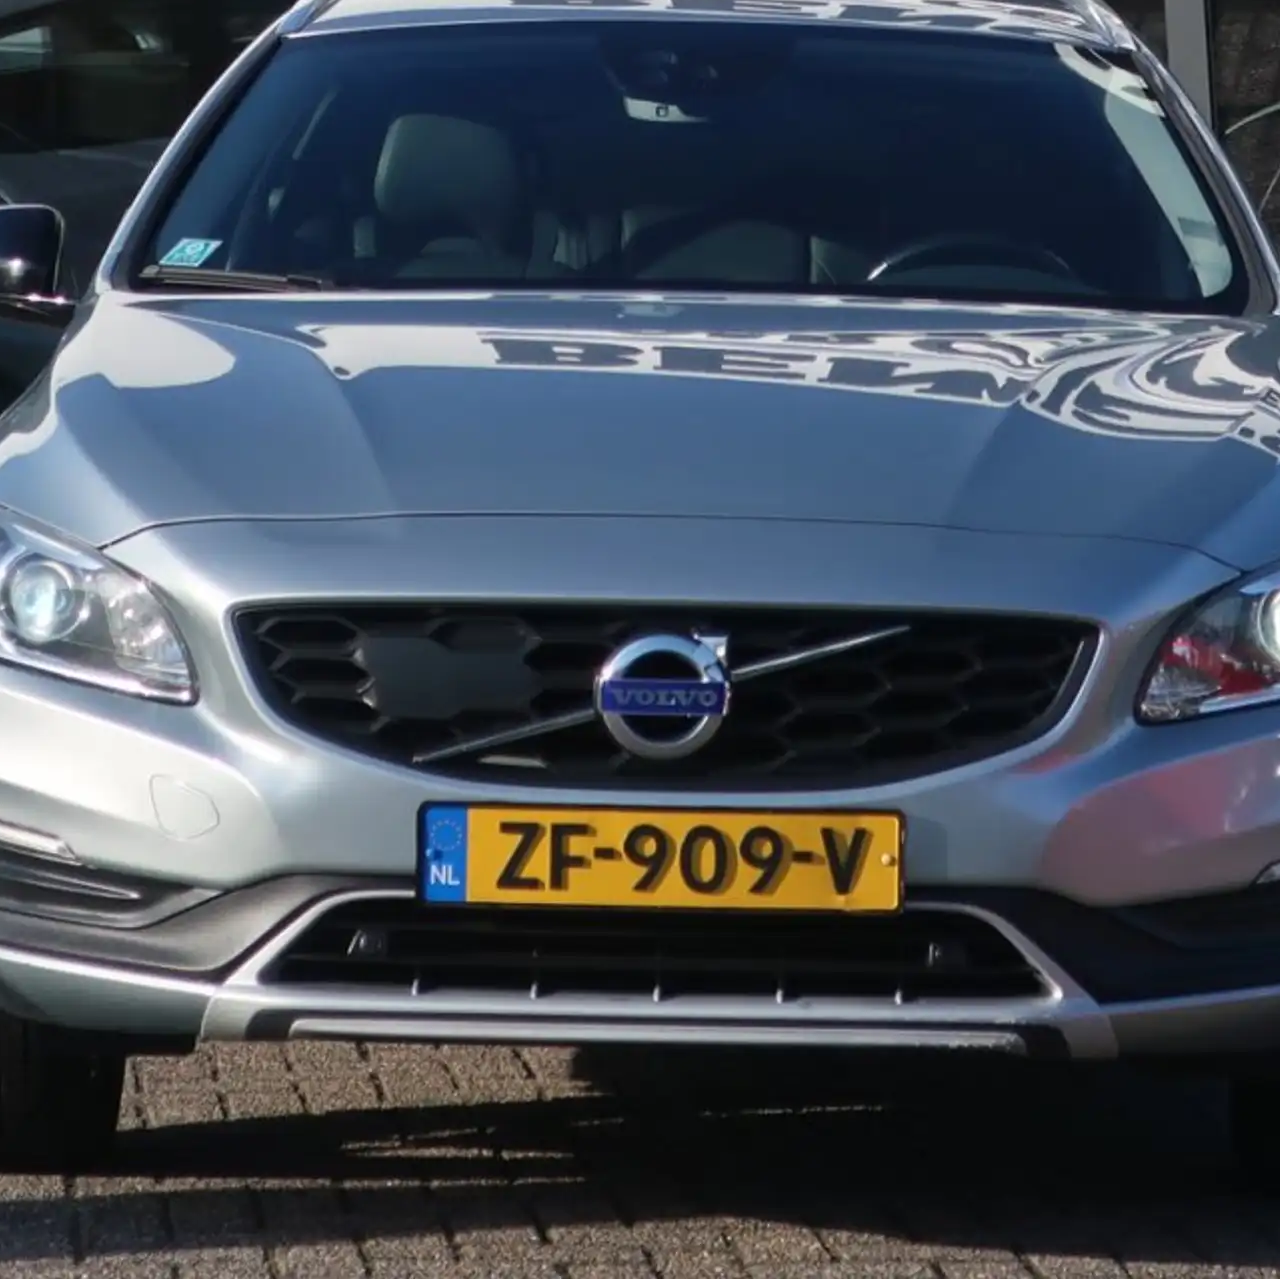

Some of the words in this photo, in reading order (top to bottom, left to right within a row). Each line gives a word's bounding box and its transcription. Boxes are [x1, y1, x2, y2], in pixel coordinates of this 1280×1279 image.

[611, 688, 718, 707] VOLVO
[430, 863, 461, 886] NL
[495, 820, 874, 896] ZF-909-V
